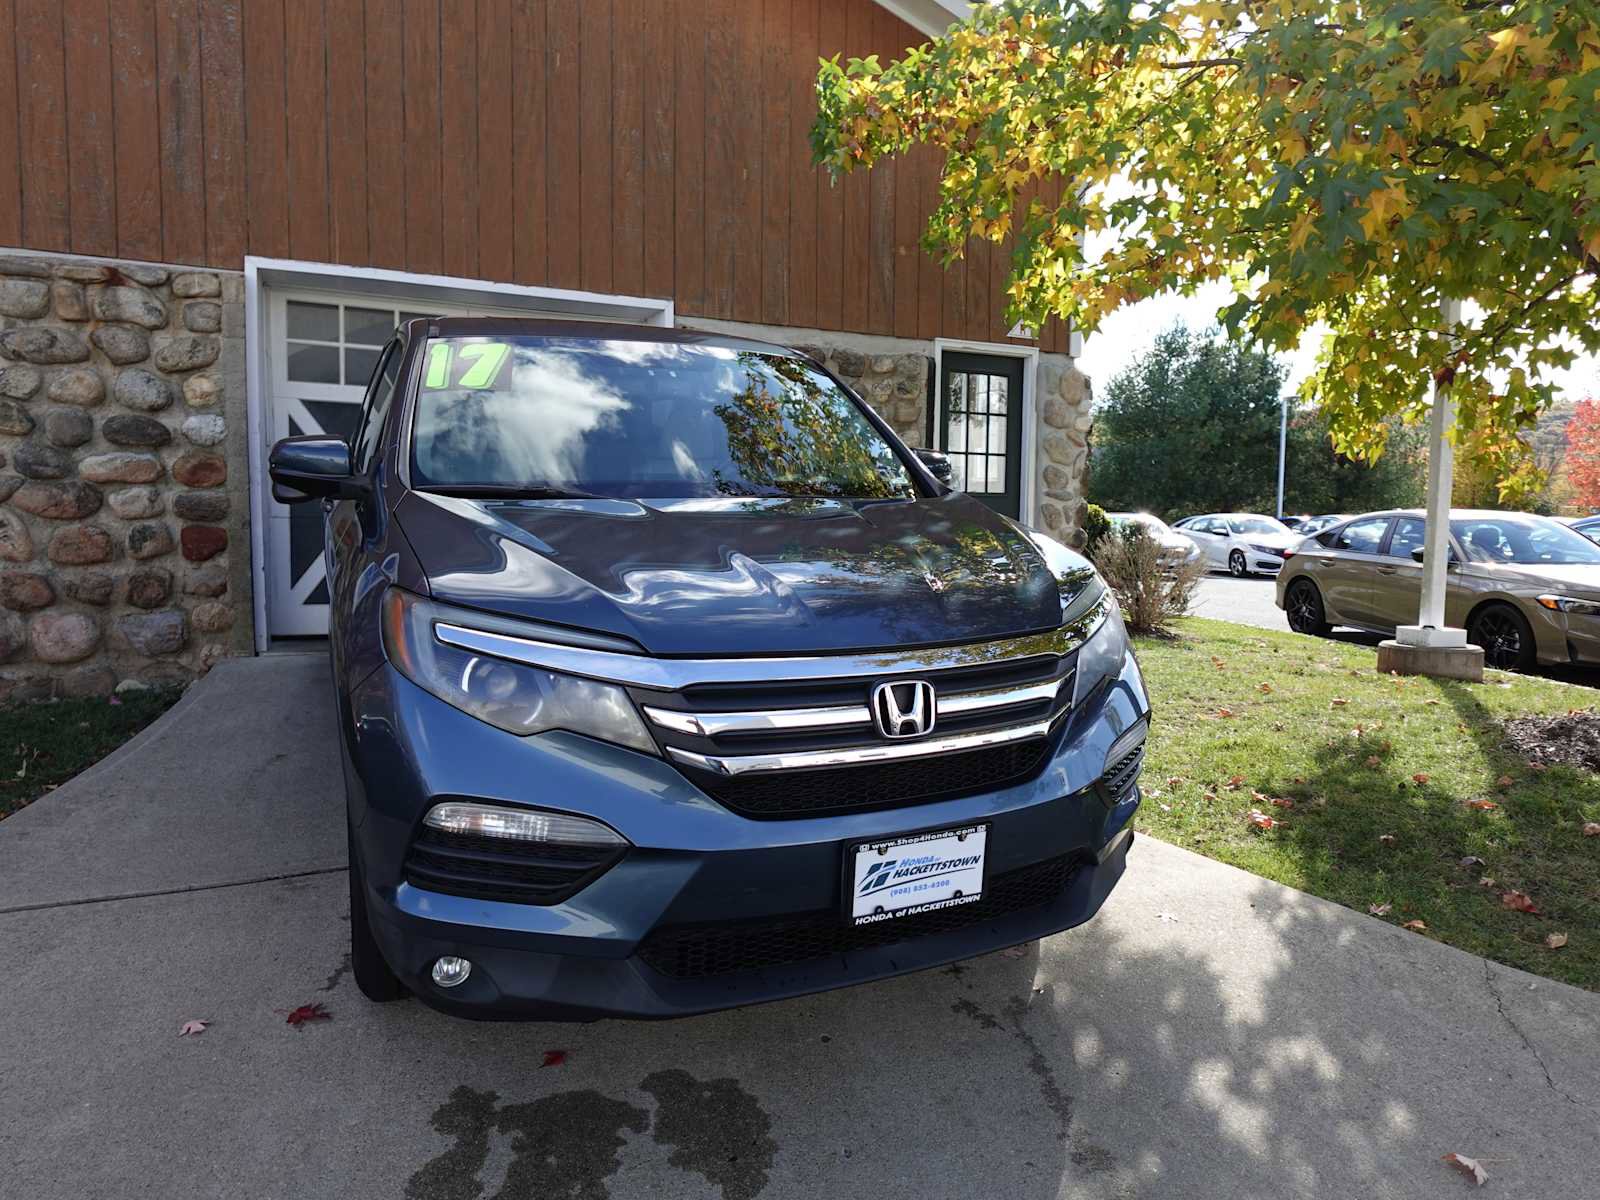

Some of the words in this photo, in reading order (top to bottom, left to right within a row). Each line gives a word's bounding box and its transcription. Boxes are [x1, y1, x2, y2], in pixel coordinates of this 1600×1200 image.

[426, 343, 511, 390] 17
[871, 828, 976, 850] www.Shop4Honda.com
[893, 855, 982, 879] HACKETTSTOWN
[899, 855, 935, 868] HONDA
[855, 912, 893, 926] HONDA
[896, 908, 906, 918] of
[907, 894, 981, 916] HACKETTSTOWN
